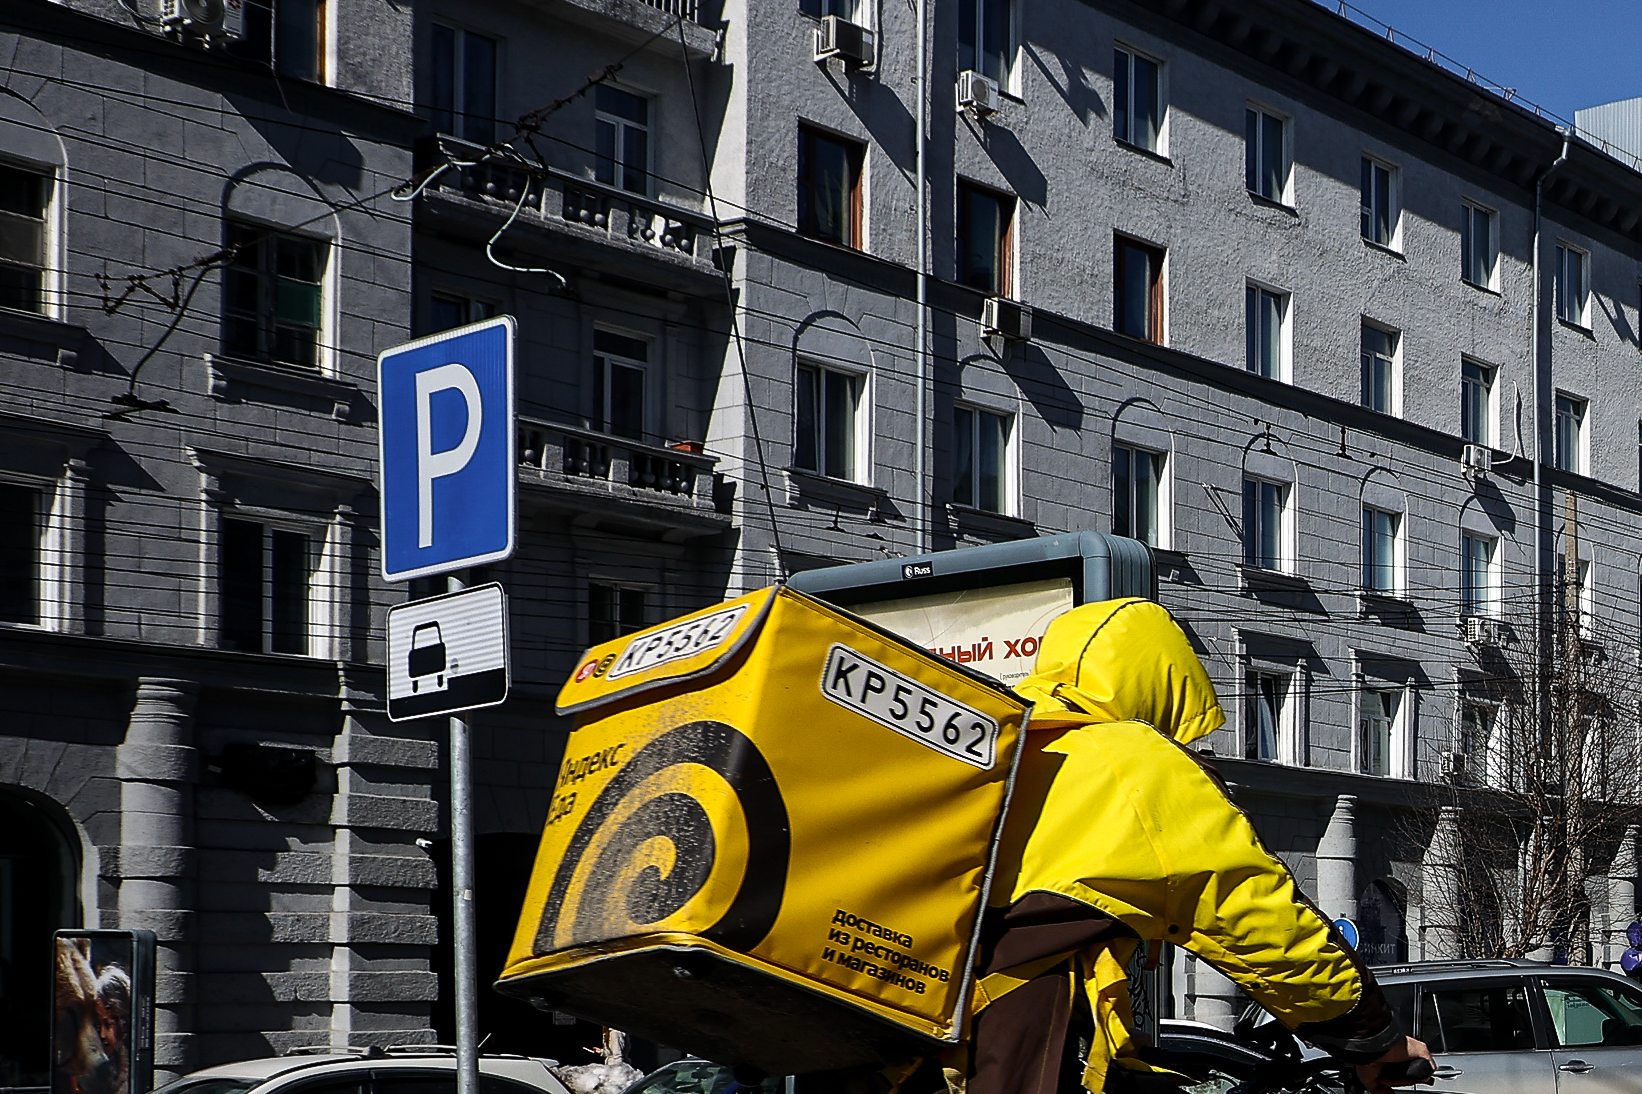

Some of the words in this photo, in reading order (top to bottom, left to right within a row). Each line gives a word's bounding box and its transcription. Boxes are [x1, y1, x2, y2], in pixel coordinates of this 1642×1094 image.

[415, 363, 483, 549] P
[914, 566, 931, 576] Russ
[617, 613, 736, 672] КР5562
[928, 637, 994, 663] НЫЙ
[831, 655, 987, 758] КР5562
[831, 908, 914, 949] доставка
[821, 946, 837, 962] и
[836, 952, 926, 995] магазинов
[827, 928, 852, 946] из
[850, 936, 951, 983] ресторанов
